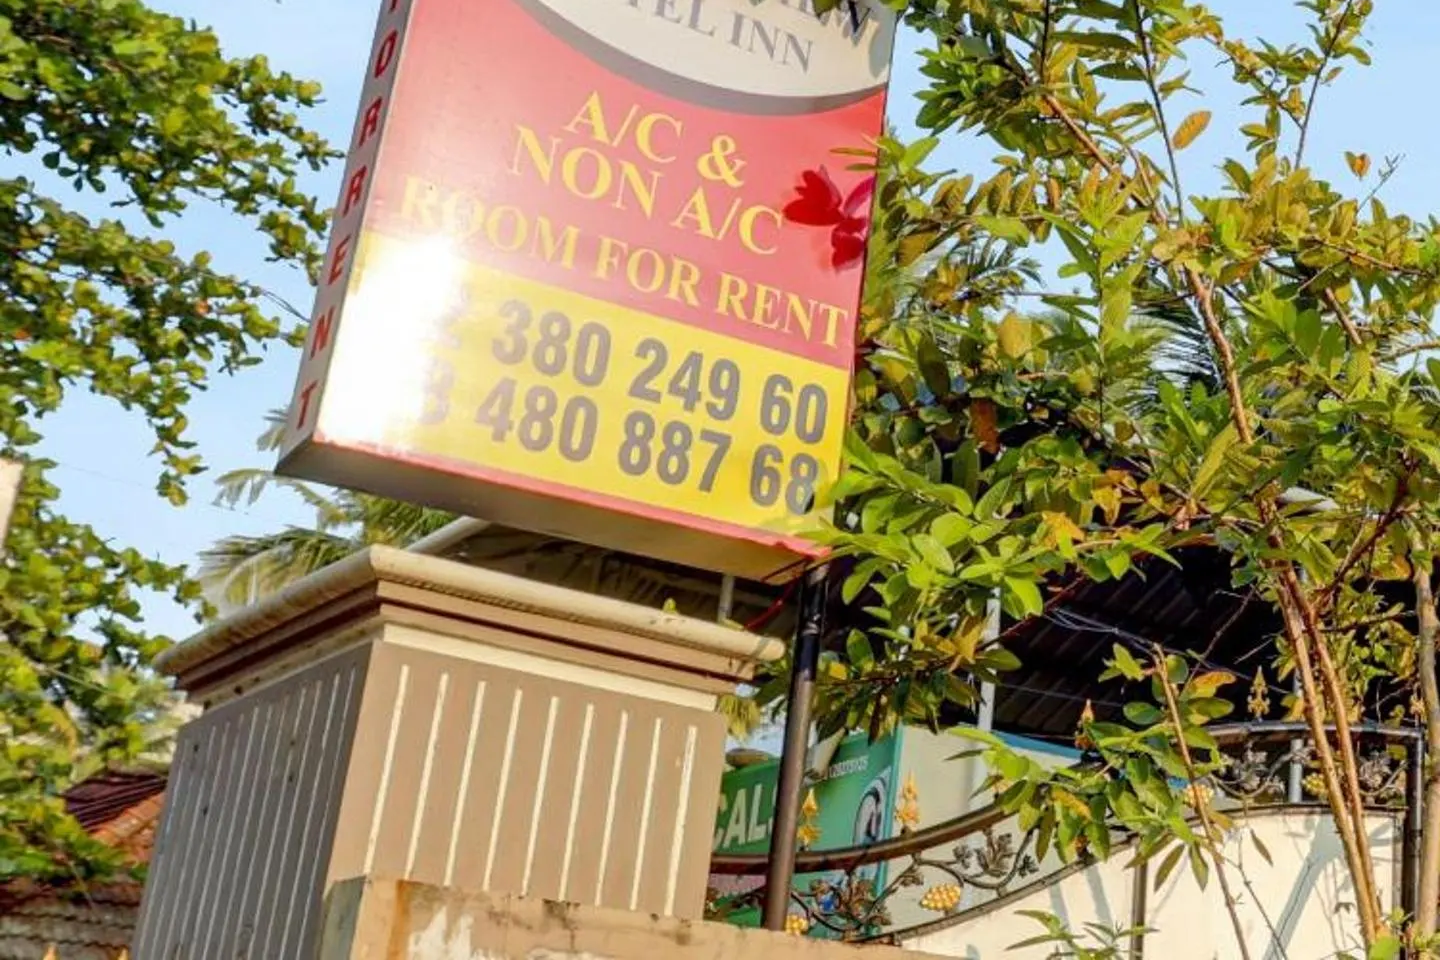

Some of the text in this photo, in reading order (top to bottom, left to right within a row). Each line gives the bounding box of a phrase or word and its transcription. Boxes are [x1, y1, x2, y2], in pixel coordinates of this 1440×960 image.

[728, 10, 814, 73] INN
[506, 124, 783, 256] NON A/C
[565, 90, 747, 189] A/C &
[396, 174, 849, 348] ROOM FOR RENT
[491, 298, 612, 387] 380
[627, 337, 742, 422] 249
[759, 373, 828, 445] 60
[473, 376, 599, 463] 480
[617, 410, 732, 493] 887
[749, 443, 820, 515] 68
